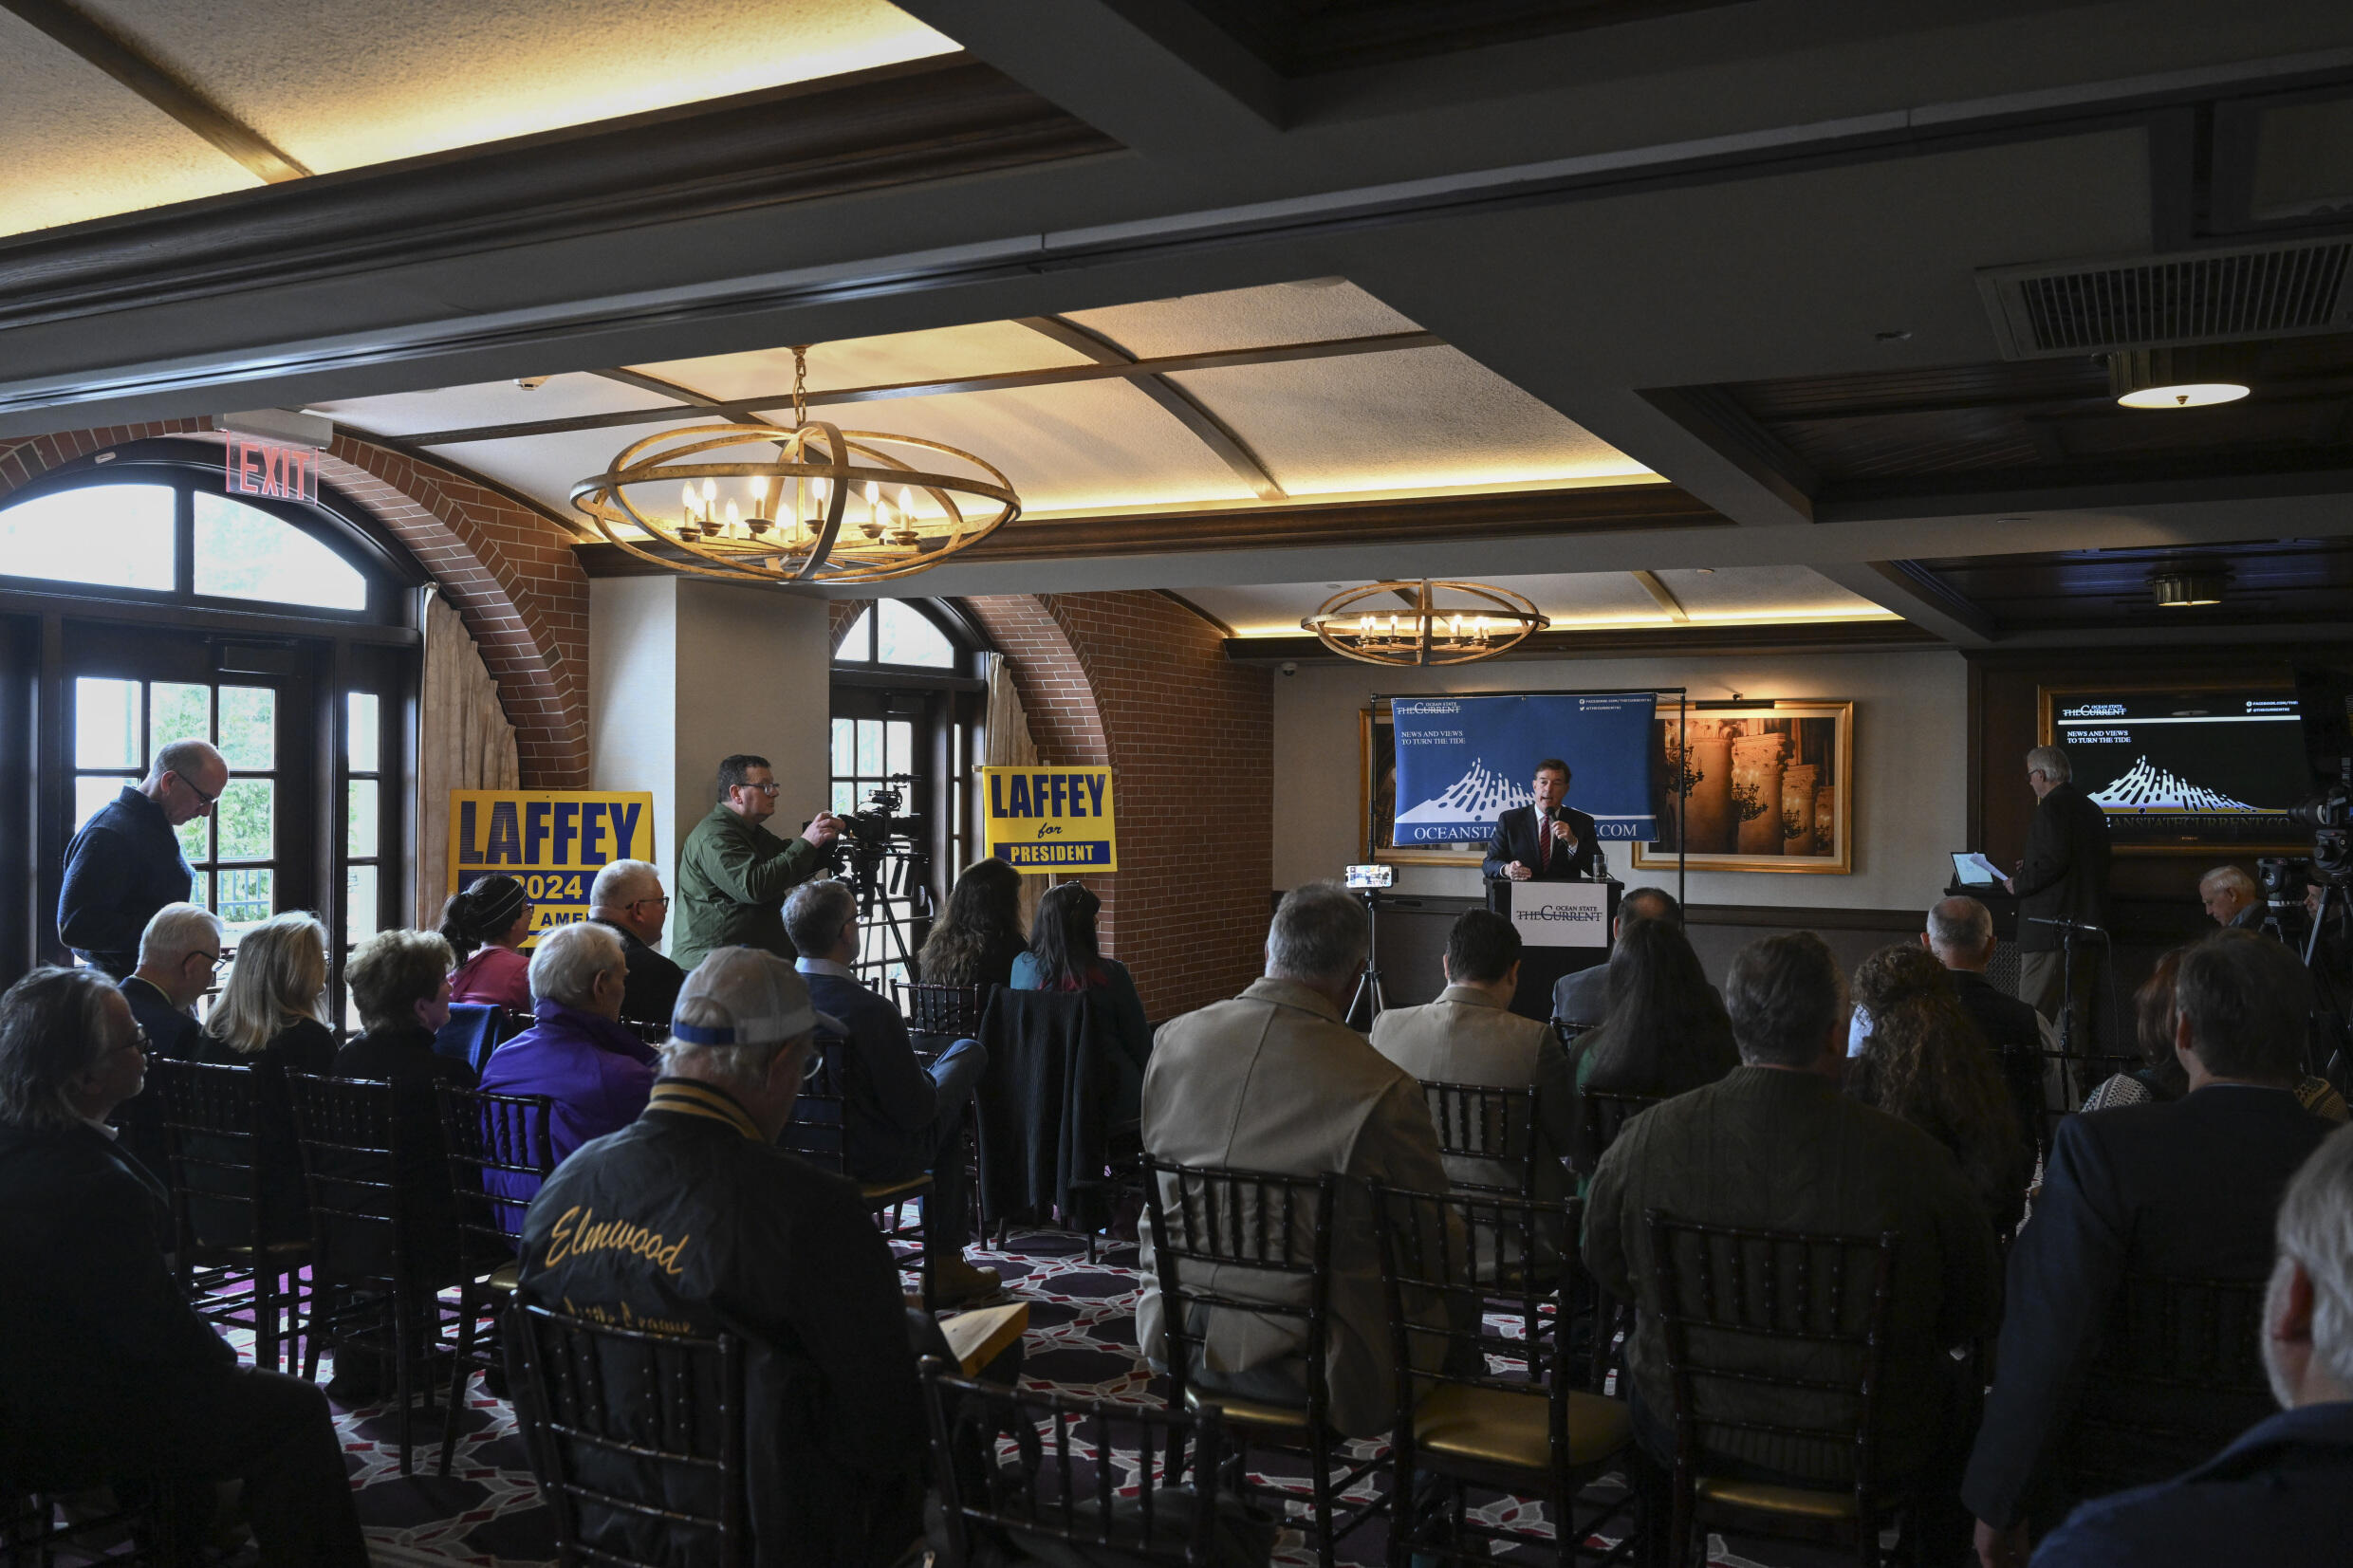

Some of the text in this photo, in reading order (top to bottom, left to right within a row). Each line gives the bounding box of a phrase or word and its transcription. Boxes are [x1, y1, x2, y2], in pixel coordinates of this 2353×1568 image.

[239, 441, 310, 501] EXIT
[991, 773, 1106, 819] LAFFEY
[459, 801, 642, 865] LAFFEY
[1010, 844, 1094, 862] PRESIDENT
[1037, 821, 1064, 839] for
[540, 912, 590, 927] AME
[545, 1205, 690, 1275] Elmwood
